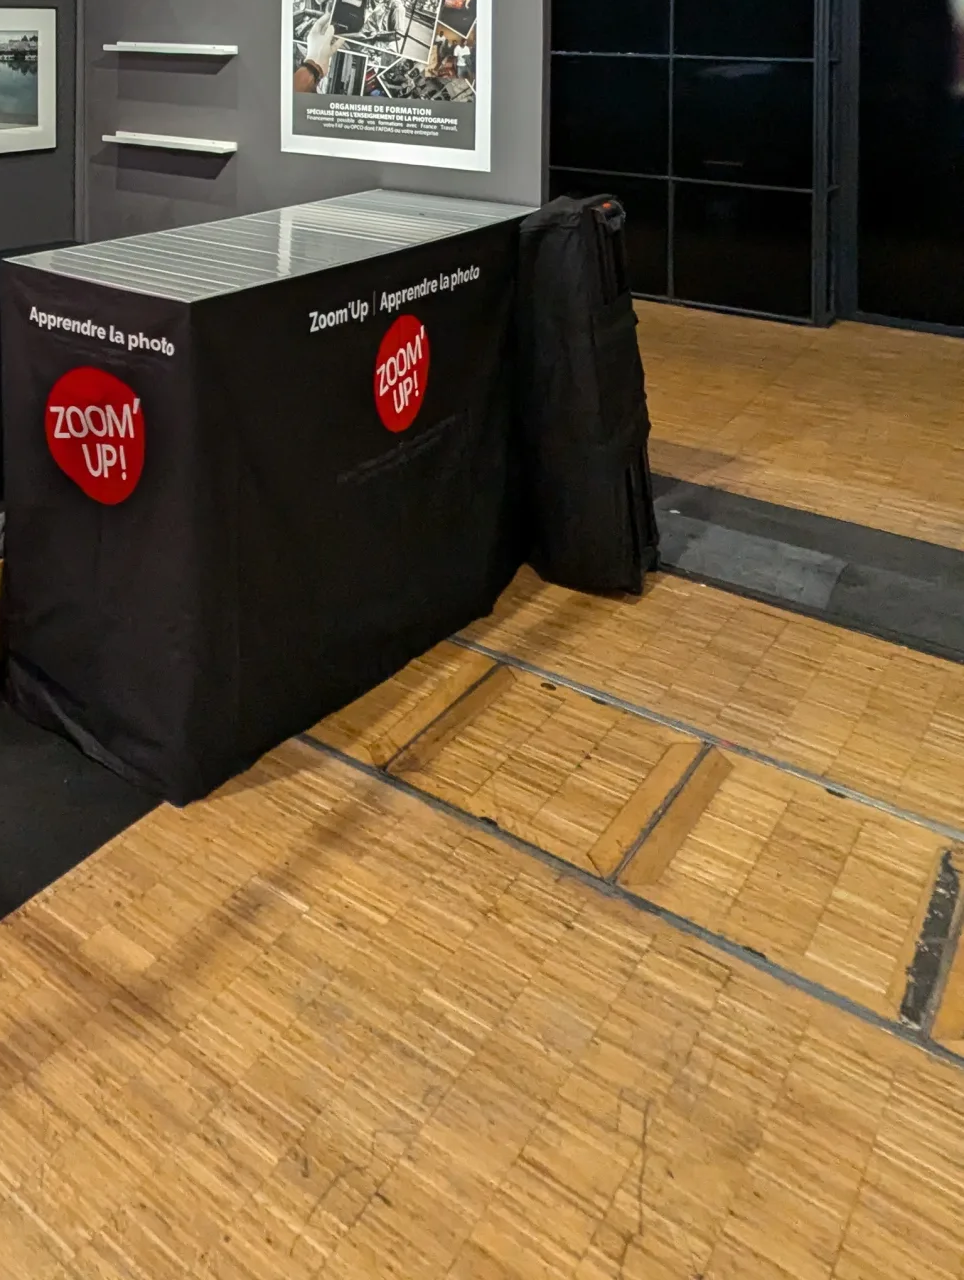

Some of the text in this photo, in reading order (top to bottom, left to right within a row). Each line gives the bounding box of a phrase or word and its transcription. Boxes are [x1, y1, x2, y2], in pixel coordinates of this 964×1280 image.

[329, 102, 432, 116] ORGANISME DE FORMATION
[308, 265, 480, 333] Zoom'Up Apprendre la photo
[29, 306, 175, 357] Apprendre la photo
[376, 325, 425, 397] ZOOM'
[393, 370, 419, 413] UP!
[49, 397, 141, 439] ZOOM'
[81, 443, 127, 481] UP!
